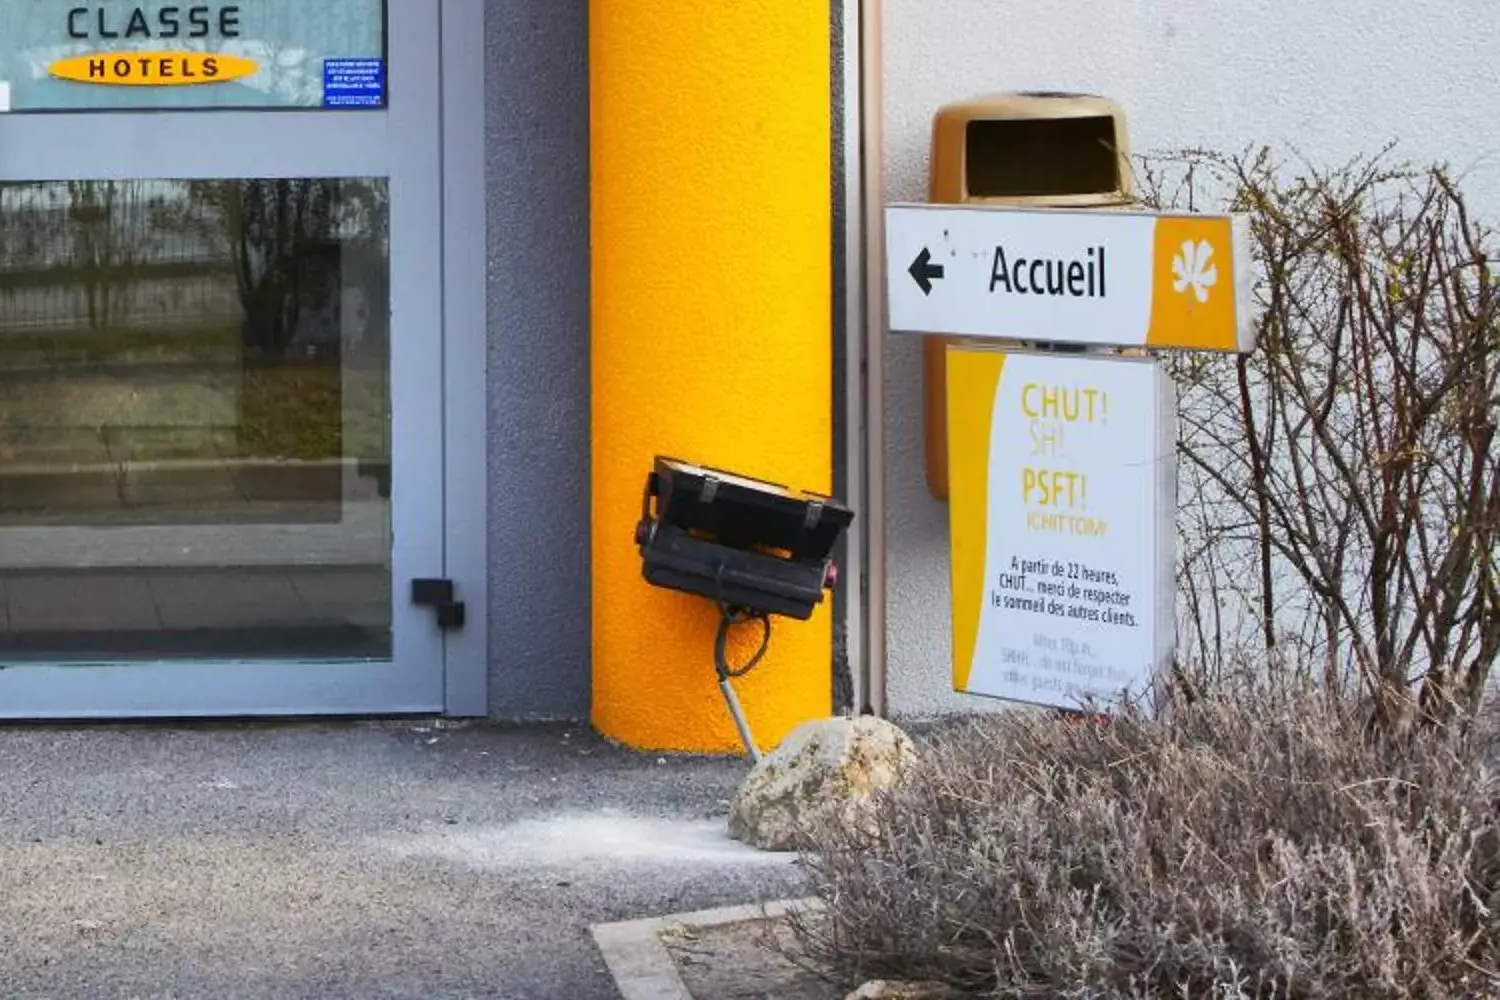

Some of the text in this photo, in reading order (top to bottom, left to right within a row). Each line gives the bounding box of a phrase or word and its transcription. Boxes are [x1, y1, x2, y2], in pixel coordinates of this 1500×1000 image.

[67, 6, 240, 38] CLASSE
[89, 57, 219, 77] HOTELS
[989, 245, 1106, 298] Accueil
[1021, 382, 1108, 425] CHUT!
[1021, 558, 1049, 575] partir
[1051, 560, 1065, 577] de
[1067, 562, 1080, 580] 22
[991, 589, 1001, 607] le
[1003, 593, 1045, 613] sommeil
[1047, 600, 1065, 617] des
[1067, 602, 1099, 622] autres
[1037, 580, 1065, 597] merci
[1067, 582, 1081, 599] de
[1083, 587, 1131, 608] respecter
